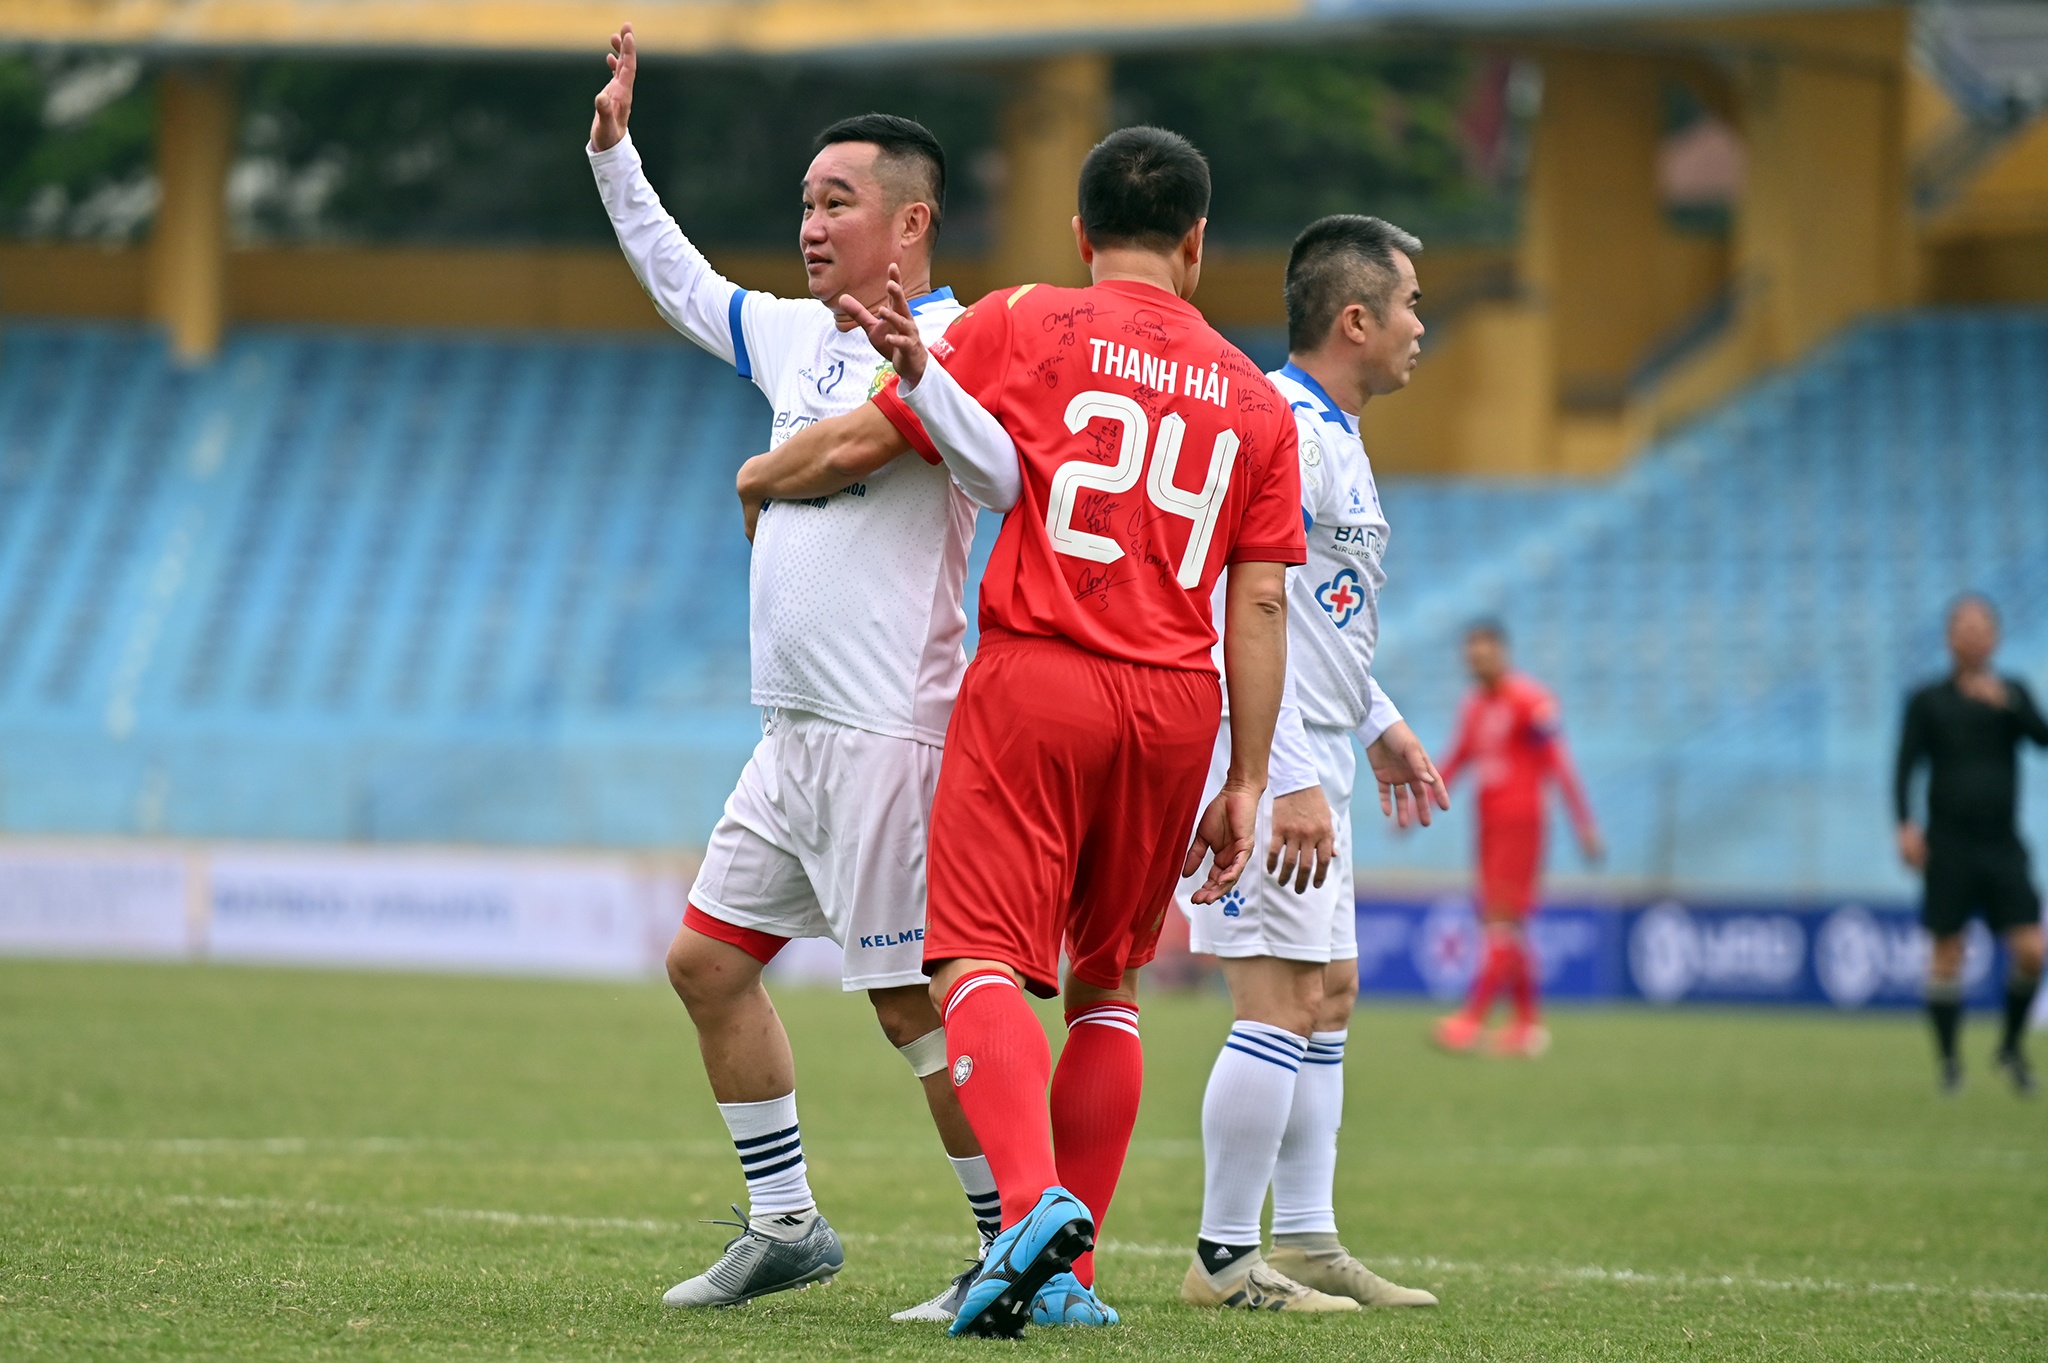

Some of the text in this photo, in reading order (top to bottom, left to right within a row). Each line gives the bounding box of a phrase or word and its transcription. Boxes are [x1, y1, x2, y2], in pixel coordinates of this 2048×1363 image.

[938, 337, 956, 353] EXT
[1089, 337, 1178, 394] THANH
[1184, 363, 1229, 409] HẢI
[1045, 390, 1240, 591] 24
[860, 928, 924, 948] KELME
